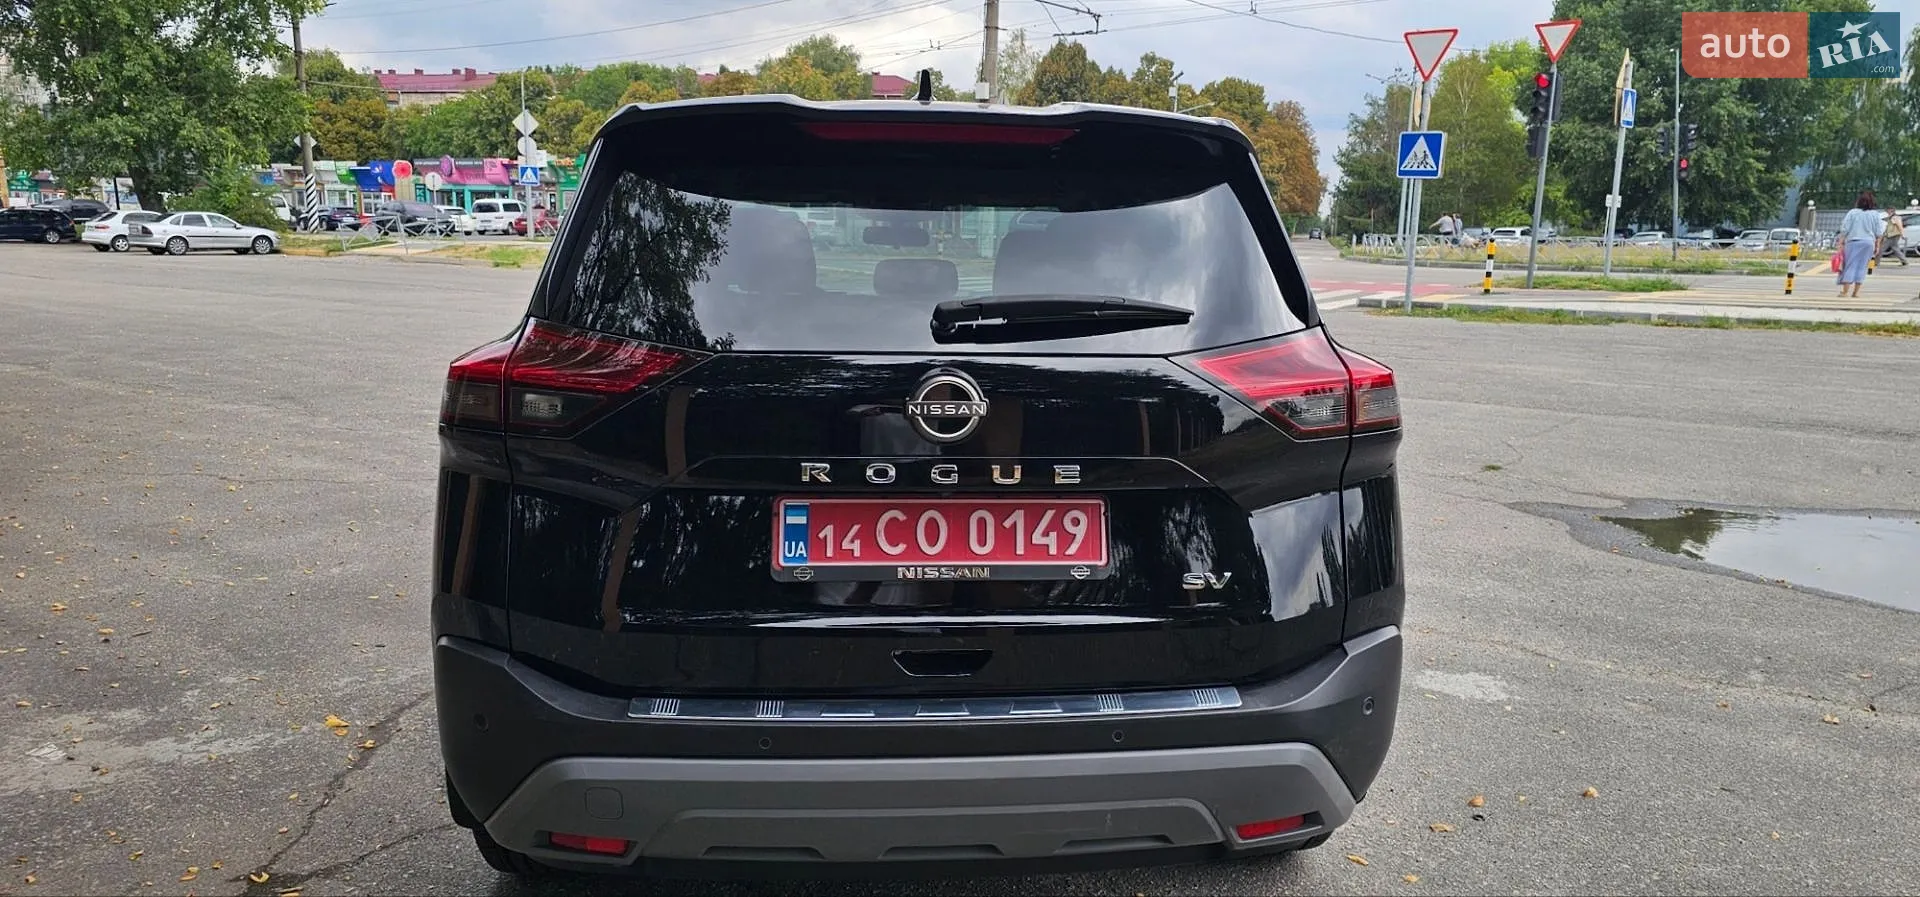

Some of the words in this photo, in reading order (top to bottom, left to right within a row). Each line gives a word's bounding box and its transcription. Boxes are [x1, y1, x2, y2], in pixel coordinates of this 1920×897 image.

[908, 404, 984, 415] NISSAN
[800, 462, 1082, 485] ROGUE
[817, 523, 862, 557] 14
[876, 508, 948, 556] CO
[968, 508, 1088, 556] 0149
[784, 540, 807, 558] UA
[897, 566, 990, 579] NISSAN
[1182, 572, 1232, 589] SV
